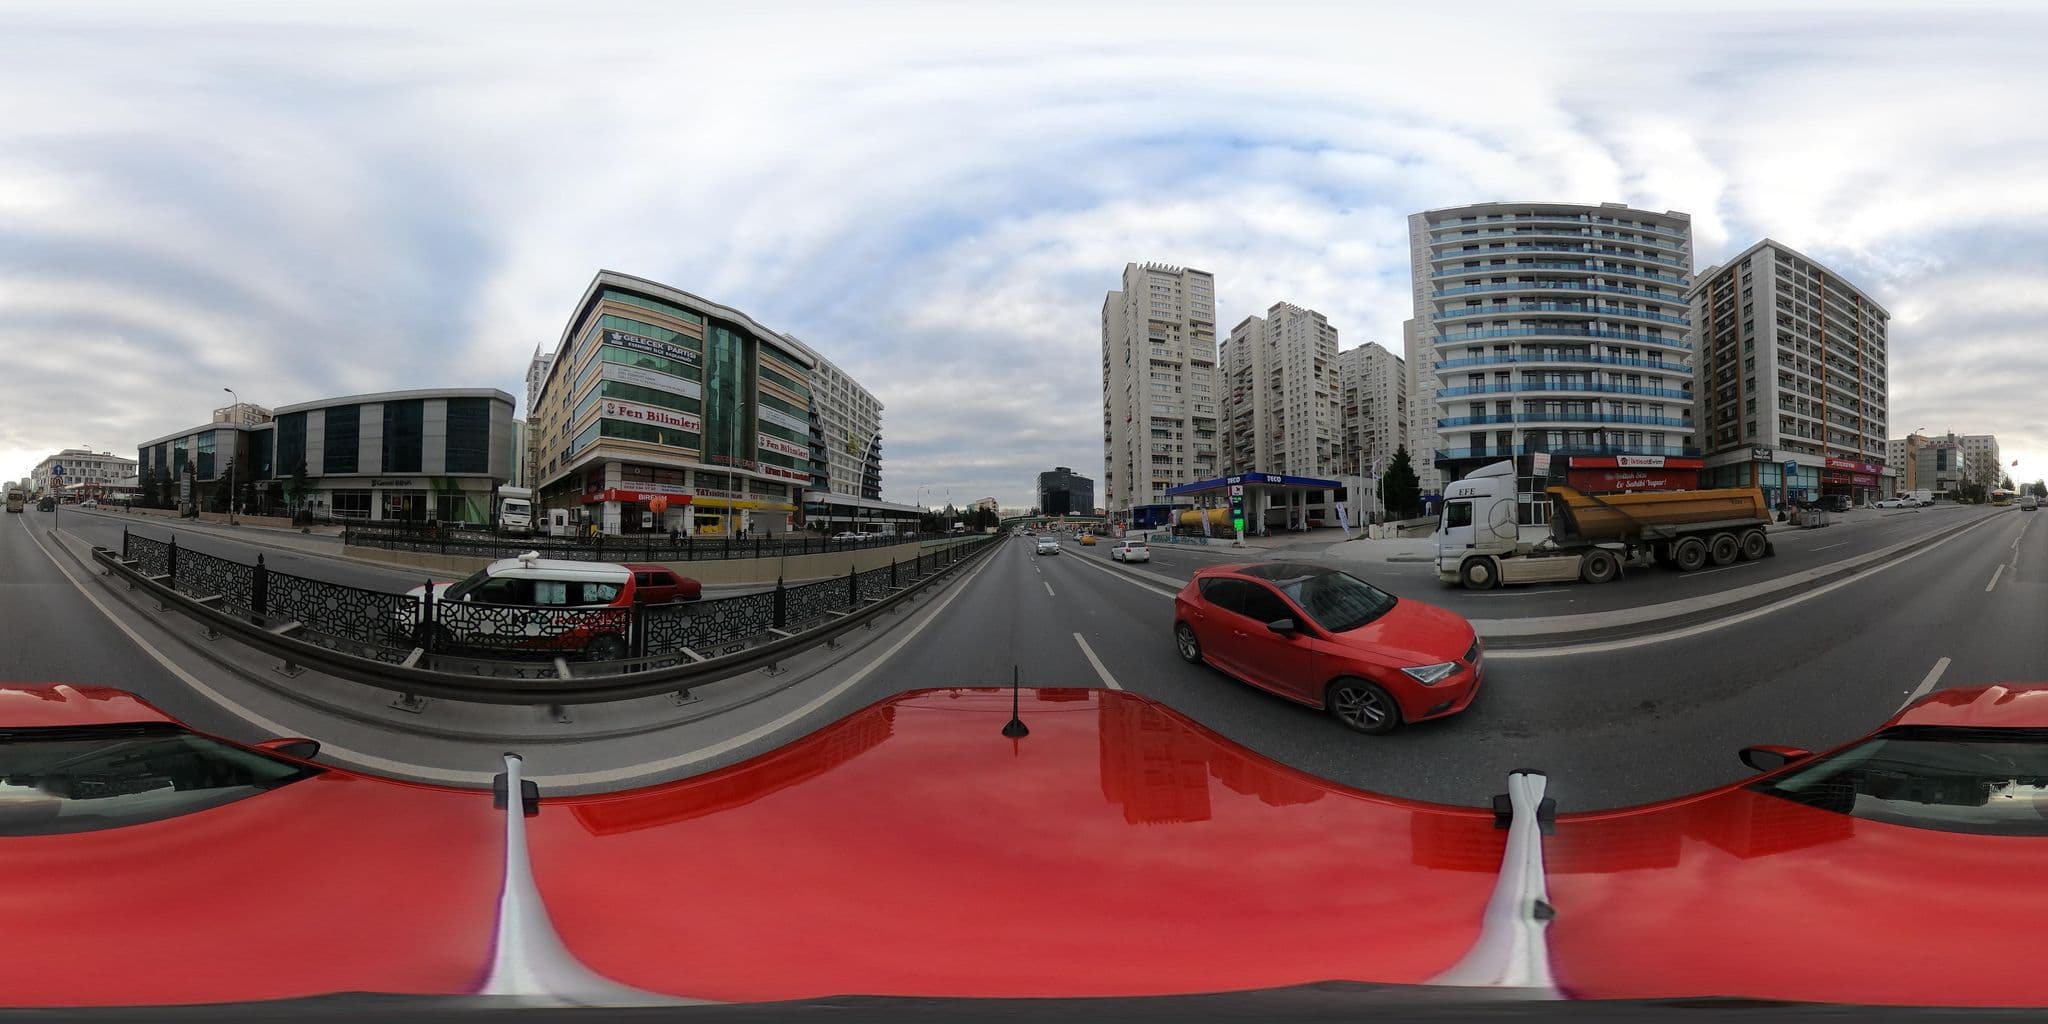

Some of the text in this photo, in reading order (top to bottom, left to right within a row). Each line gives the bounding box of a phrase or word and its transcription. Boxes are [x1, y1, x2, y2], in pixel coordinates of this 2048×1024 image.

[623, 334, 664, 350] GELECEK
[618, 406, 700, 430] Fen Bilimleri
[766, 439, 809, 460] Fen Bilimleri
[1458, 487, 1475, 496] EFE
